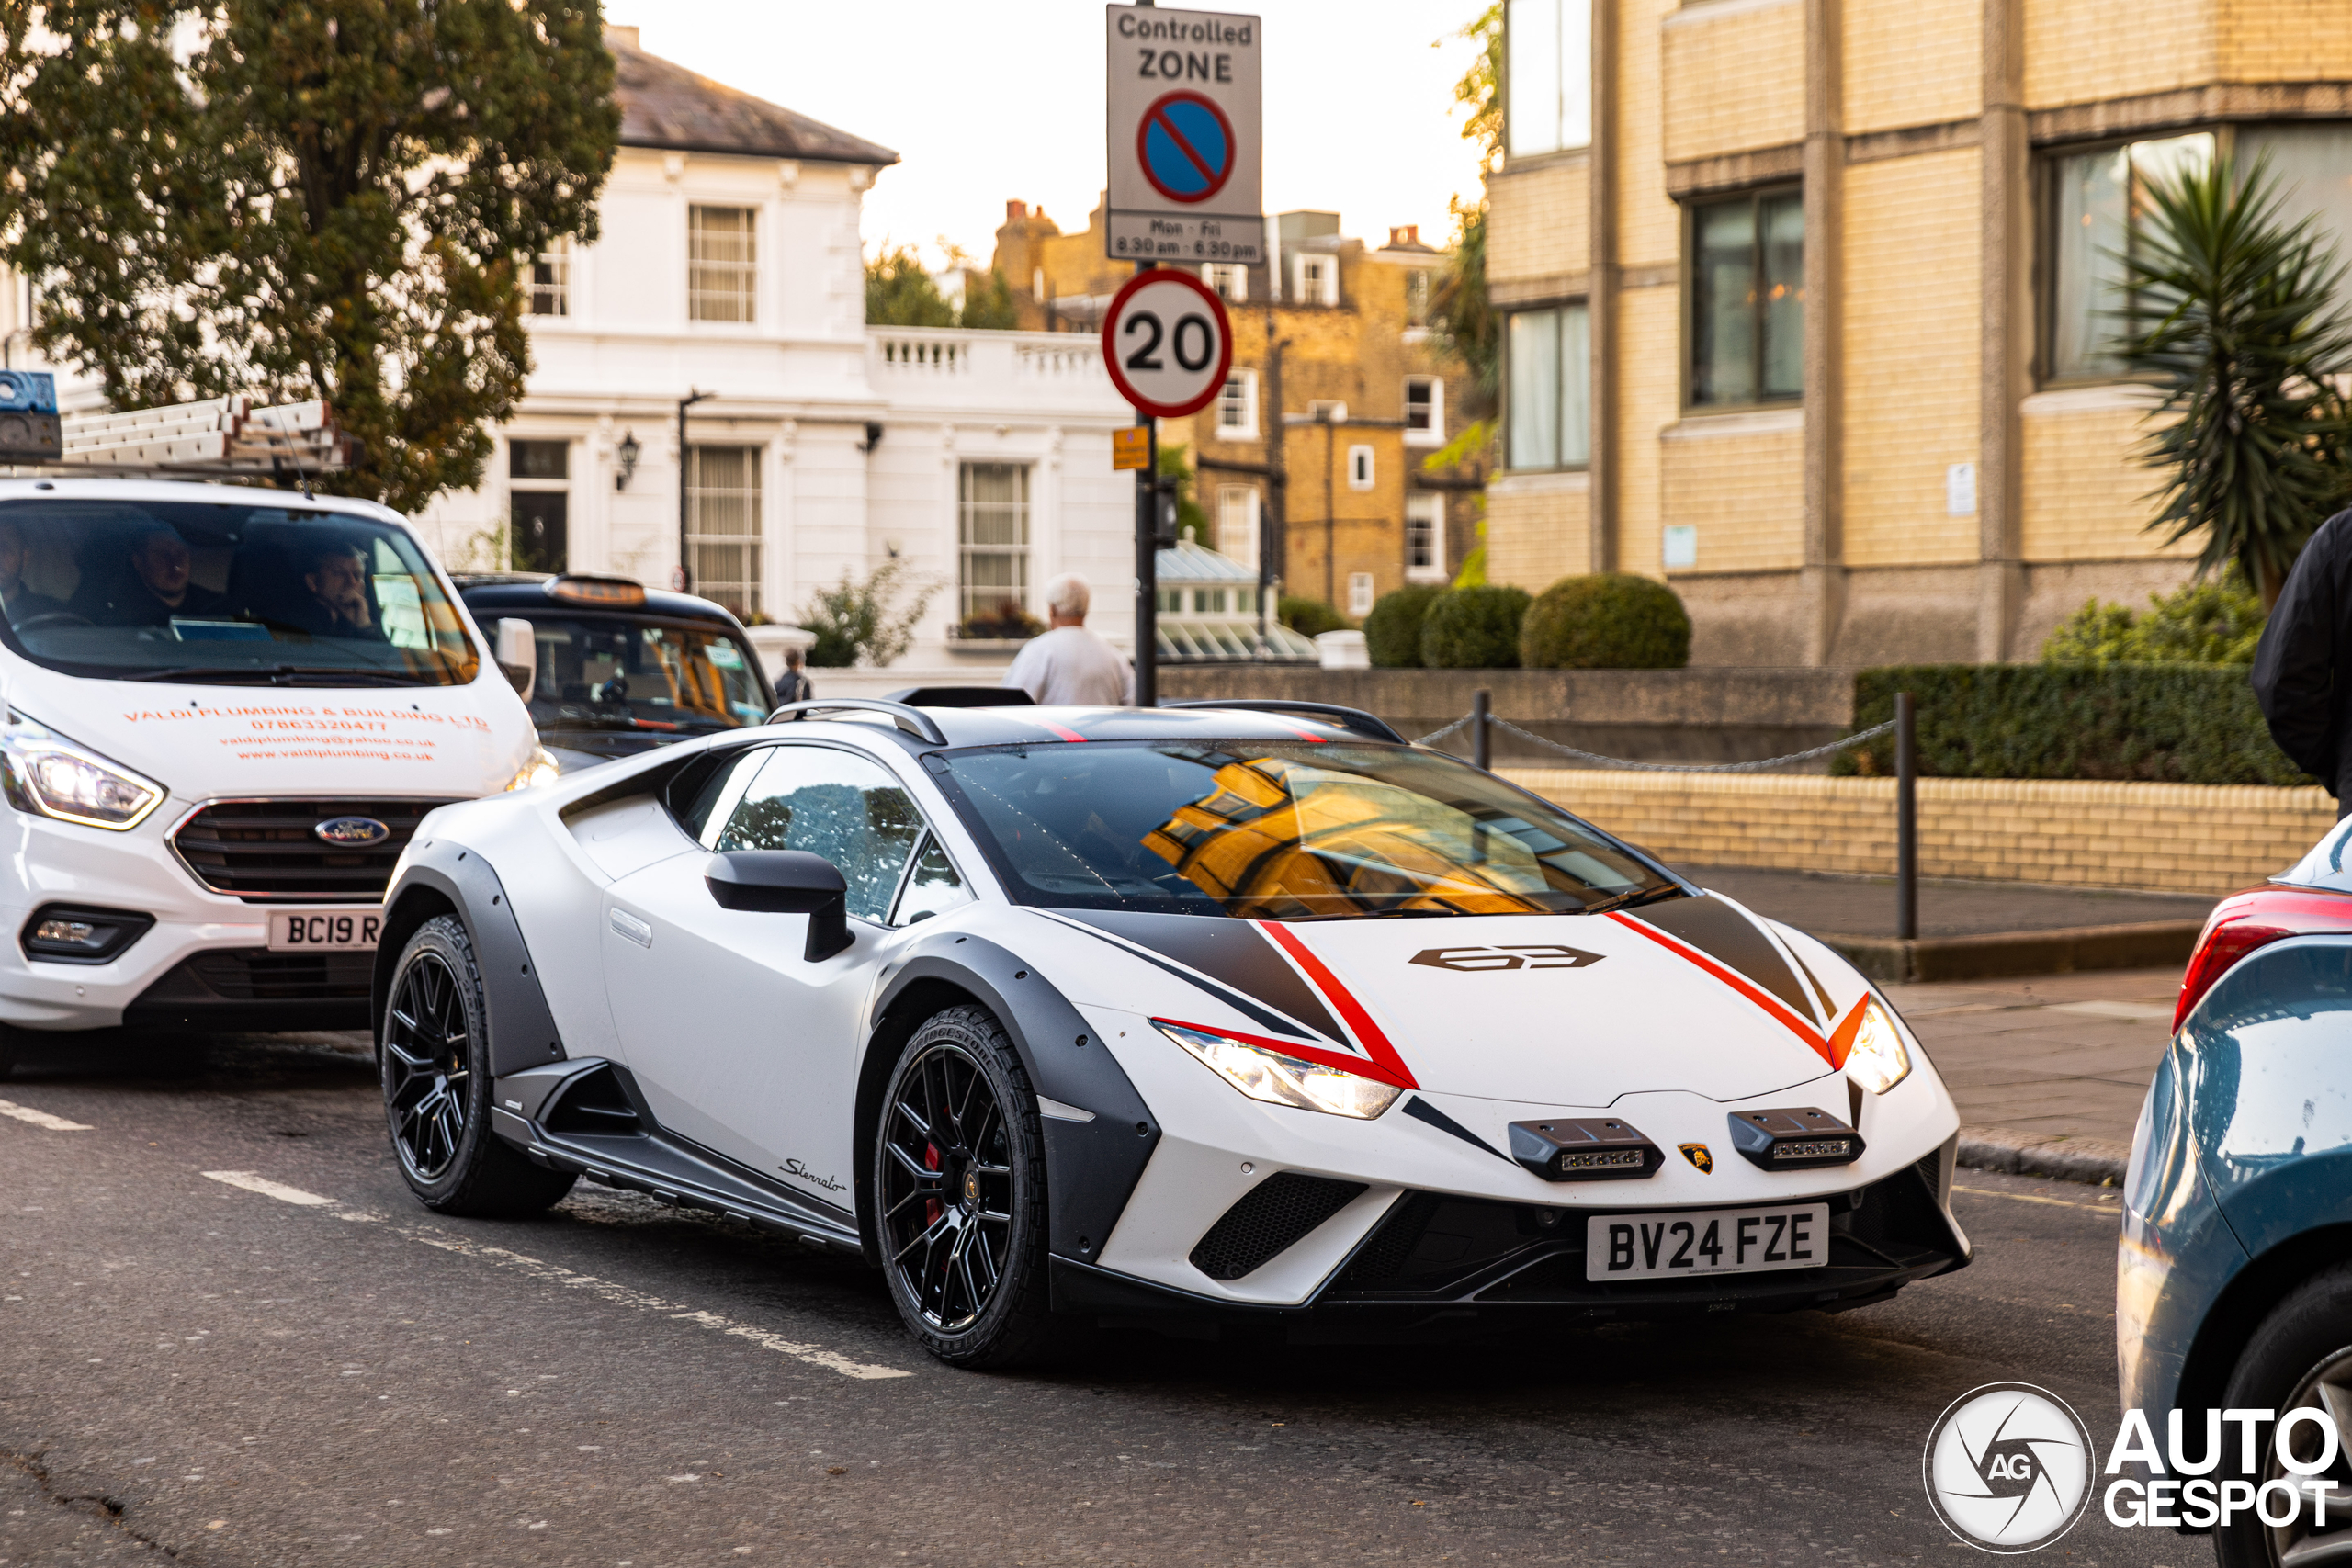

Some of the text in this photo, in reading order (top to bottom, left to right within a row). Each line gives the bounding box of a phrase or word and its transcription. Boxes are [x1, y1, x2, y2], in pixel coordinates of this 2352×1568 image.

[1117, 13, 1252, 45] Controlled
[1138, 49, 1233, 83] ZONE
[1150, 219, 1183, 236] Mon
[1200, 220, 1221, 238] Fri
[1125, 310, 1215, 372] 20
[123, 708, 193, 723] VALDI
[198, 706, 316, 718] PLUMBING
[322, 706, 337, 716] &
[342, 707, 444, 724] BUILDING
[447, 714, 488, 728] LTD
[251, 720, 387, 732] 07863320477
[219, 735, 436, 748] valdiplumbing@yahoo.co.uk
[237, 749, 435, 761] www.valdiplumbing.co.uk
[334, 820, 374, 840] Ford
[288, 916, 353, 944] BC19
[777, 1158, 847, 1192] Sterrato
[1608, 1213, 1813, 1271] BV24 FZE
